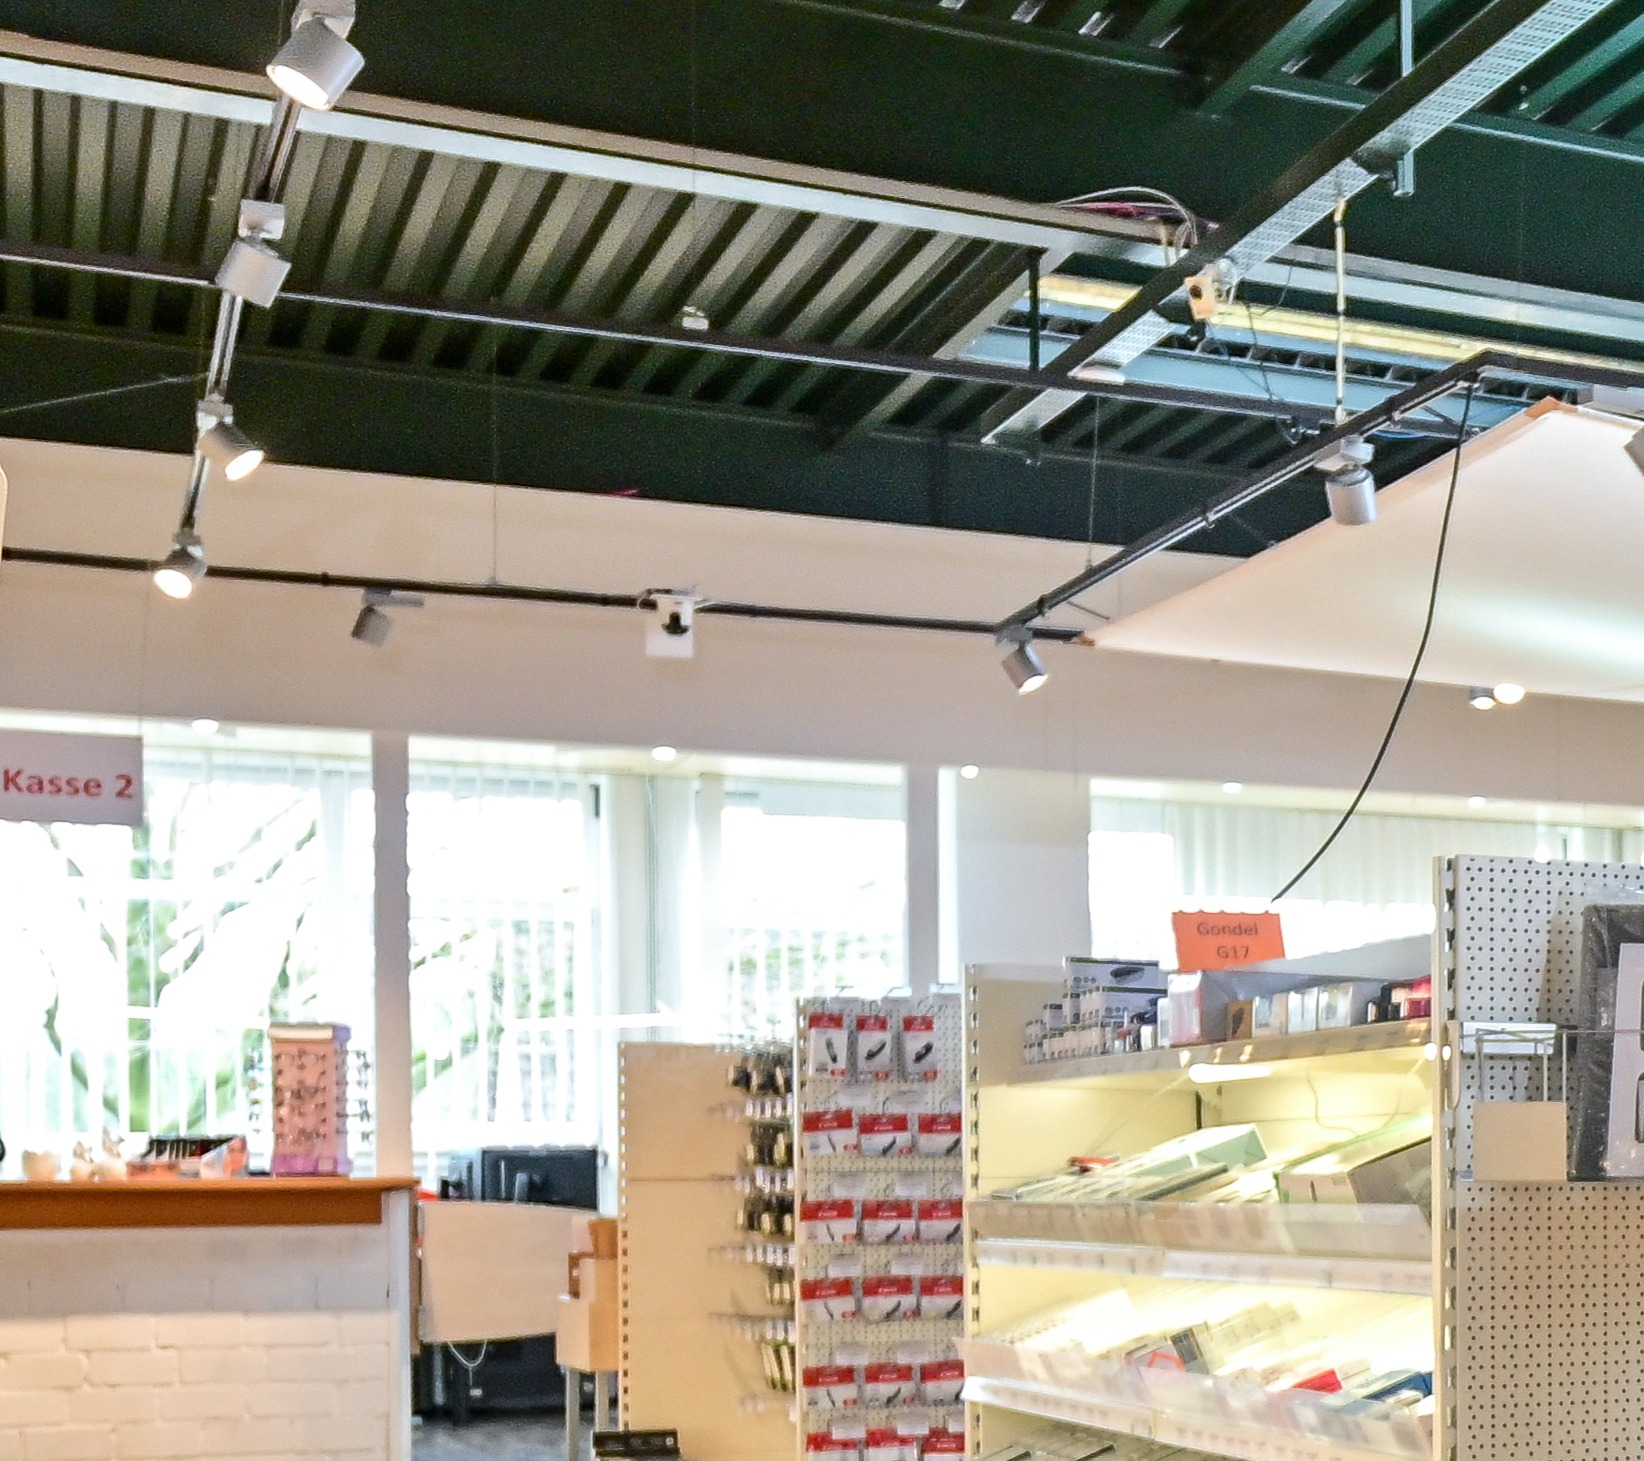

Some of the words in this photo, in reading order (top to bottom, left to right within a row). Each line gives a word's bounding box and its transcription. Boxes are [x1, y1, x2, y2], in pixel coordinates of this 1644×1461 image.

[3, 767, 102, 797] Kasse
[115, 773, 133, 799] 2
[1197, 921, 1258, 936] Gondel
[1217, 945, 1249, 959] G17
